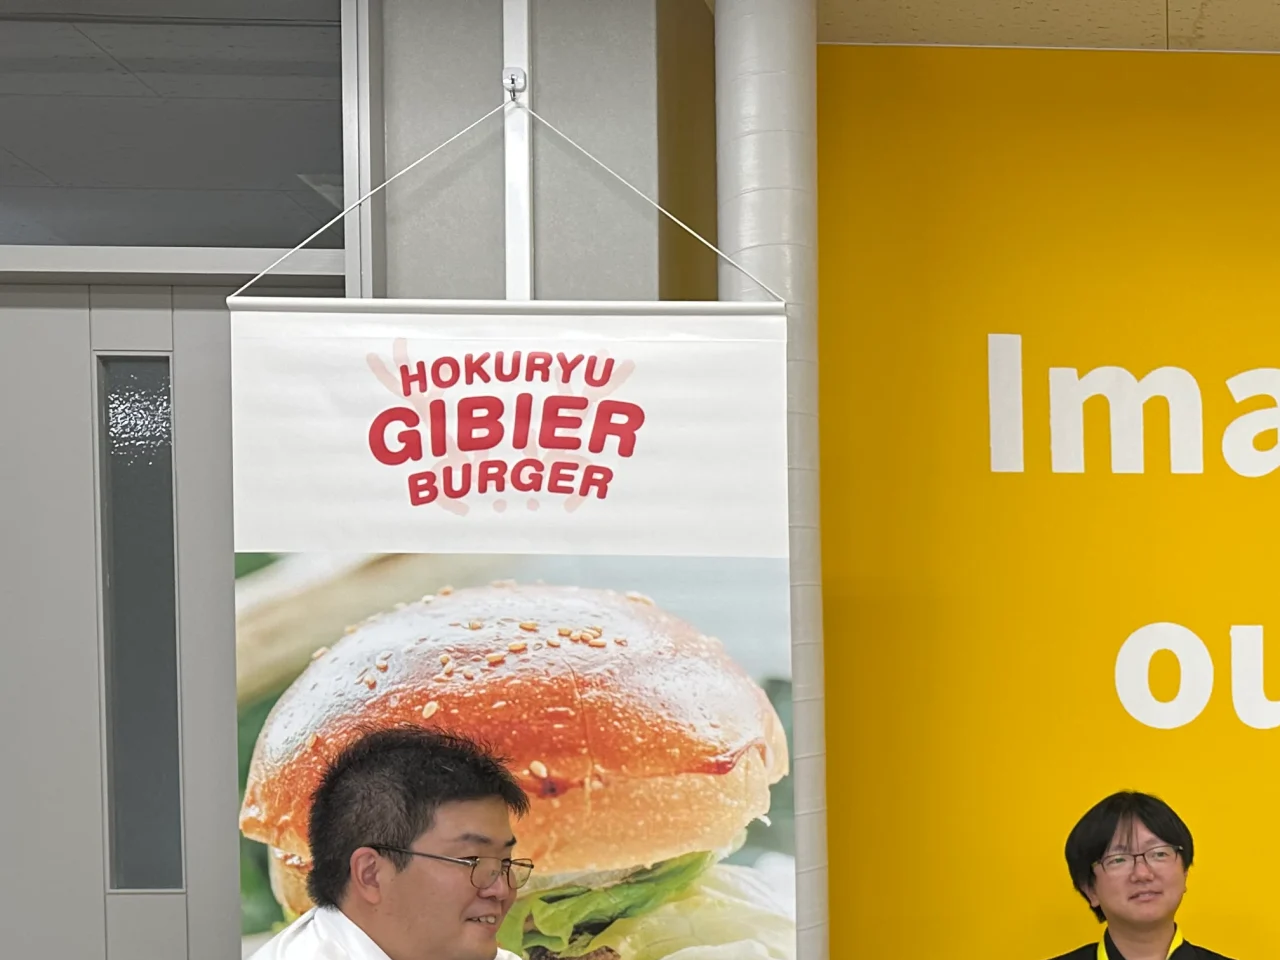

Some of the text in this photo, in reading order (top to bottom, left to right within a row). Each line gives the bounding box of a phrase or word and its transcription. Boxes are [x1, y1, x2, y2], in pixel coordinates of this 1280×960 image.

[400, 351, 615, 397] HOKURYU
[368, 392, 646, 466] GIBIER
[407, 457, 614, 506] BURGER
